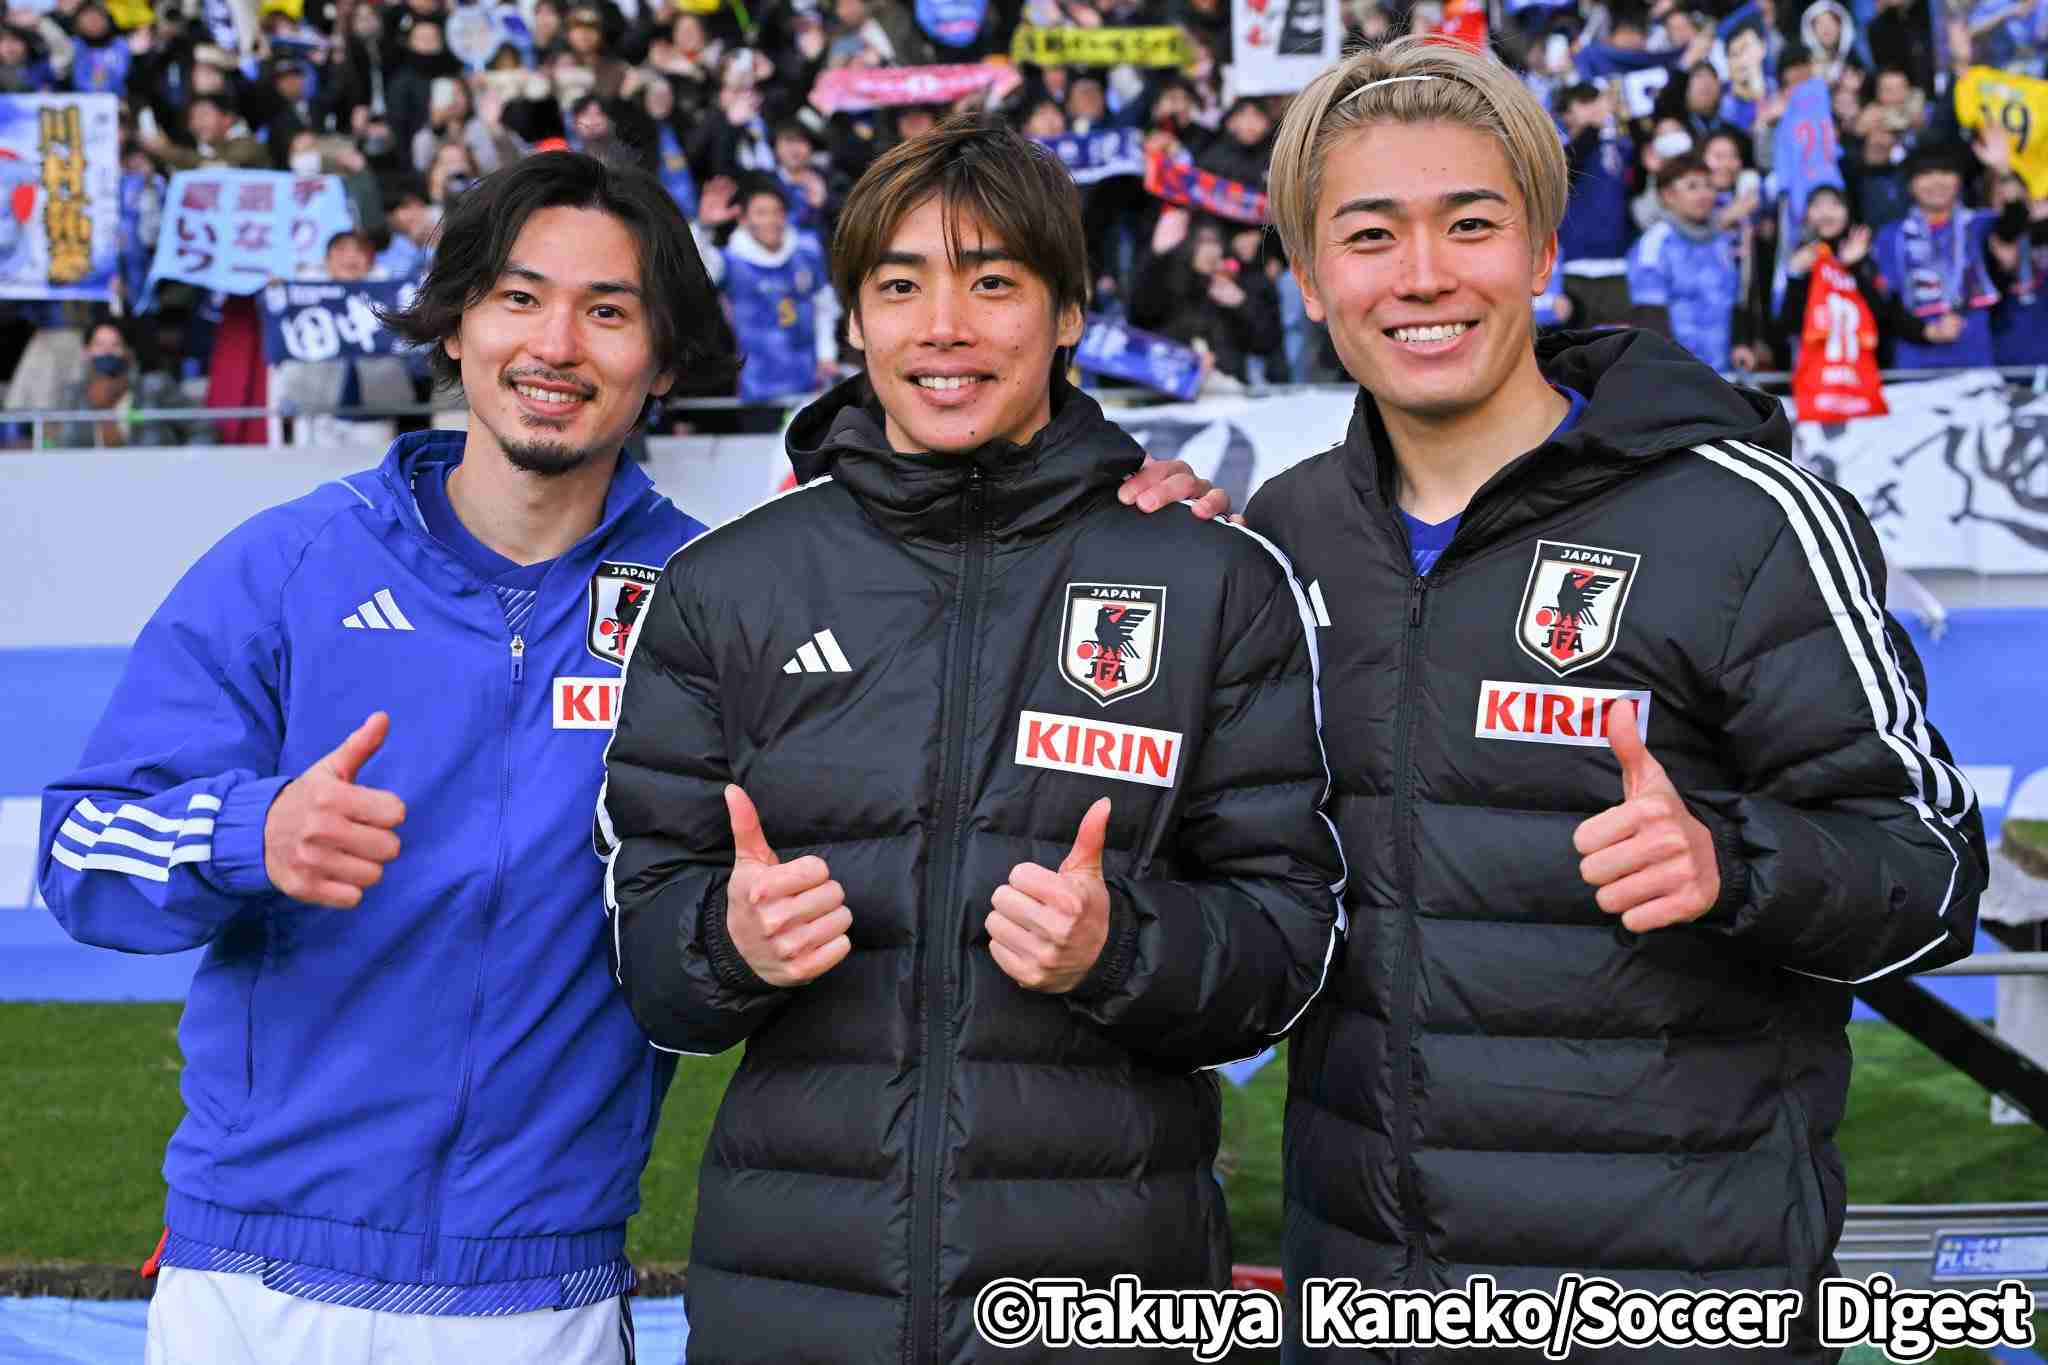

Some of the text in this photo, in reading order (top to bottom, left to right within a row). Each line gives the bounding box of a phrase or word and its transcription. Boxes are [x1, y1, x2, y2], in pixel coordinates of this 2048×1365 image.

[1560, 549, 1613, 566] JAPAN
[611, 566, 656, 580] JAPAN
[1091, 588, 1141, 600] JAPAN
[1541, 629, 1584, 653] JFA
[1084, 660, 1128, 683] JFA
[1026, 720, 1173, 778] KIRIN
